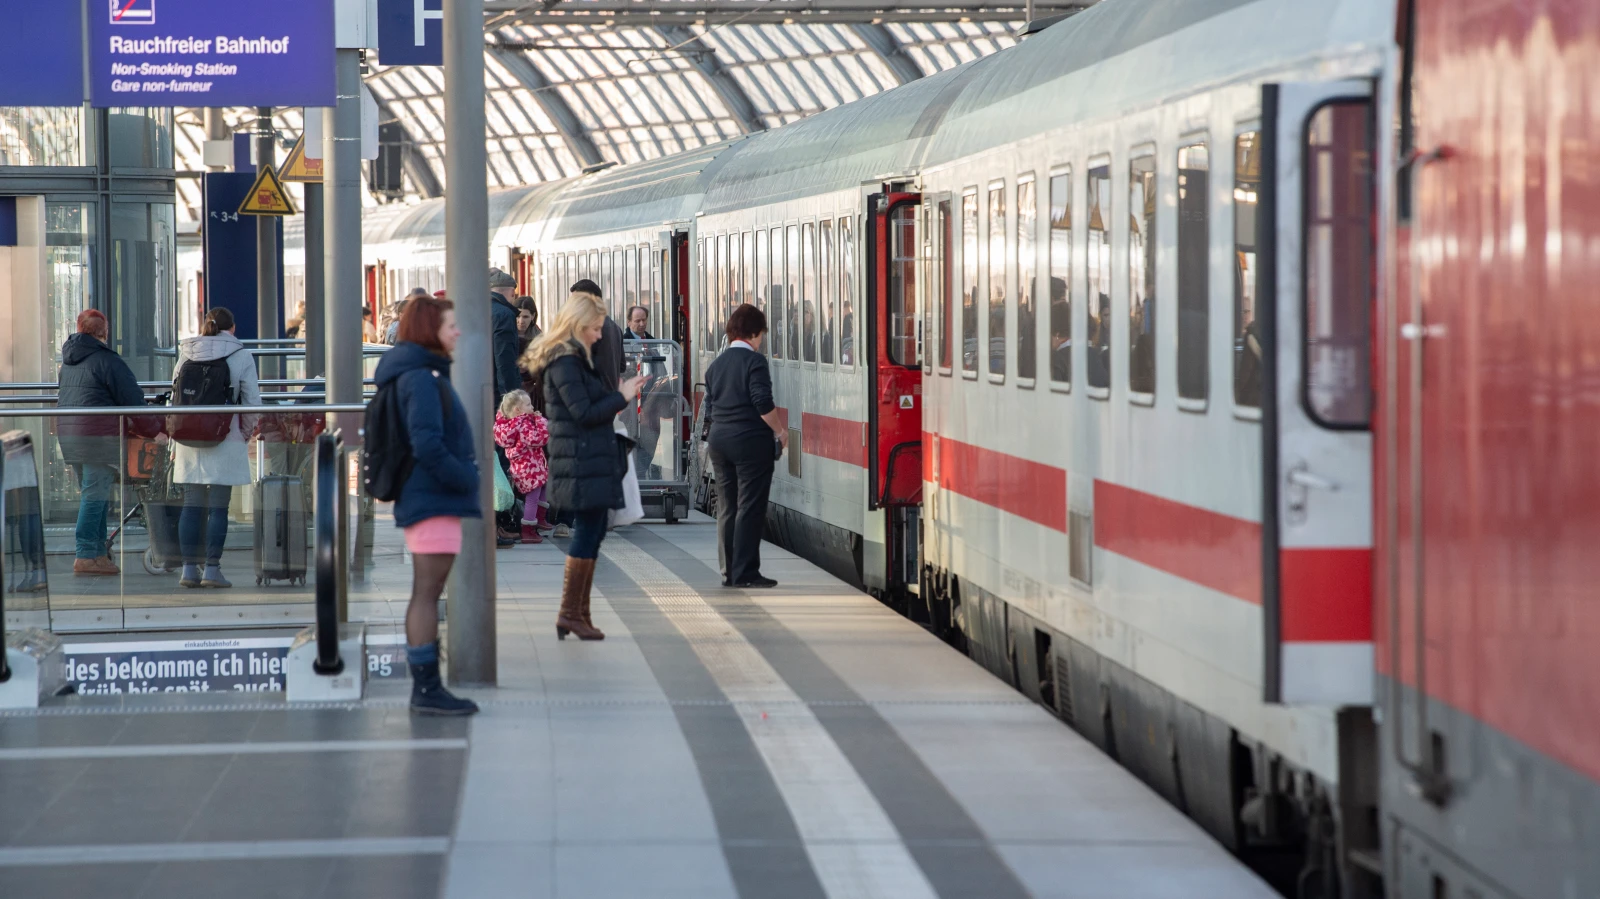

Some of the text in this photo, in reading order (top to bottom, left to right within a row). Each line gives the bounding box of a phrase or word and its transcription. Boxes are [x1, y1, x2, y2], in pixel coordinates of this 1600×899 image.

[110, 36, 289, 54] Rauchfreier Bahnhof
[111, 62, 237, 77] Non-Smoking Station
[111, 79, 213, 92] Gare non-fumeur
[184, 640, 240, 648] einkaufsbahnhof.de
[105, 656, 208, 680] bekomme
[213, 653, 243, 676] ich
[367, 653, 392, 676] ag
